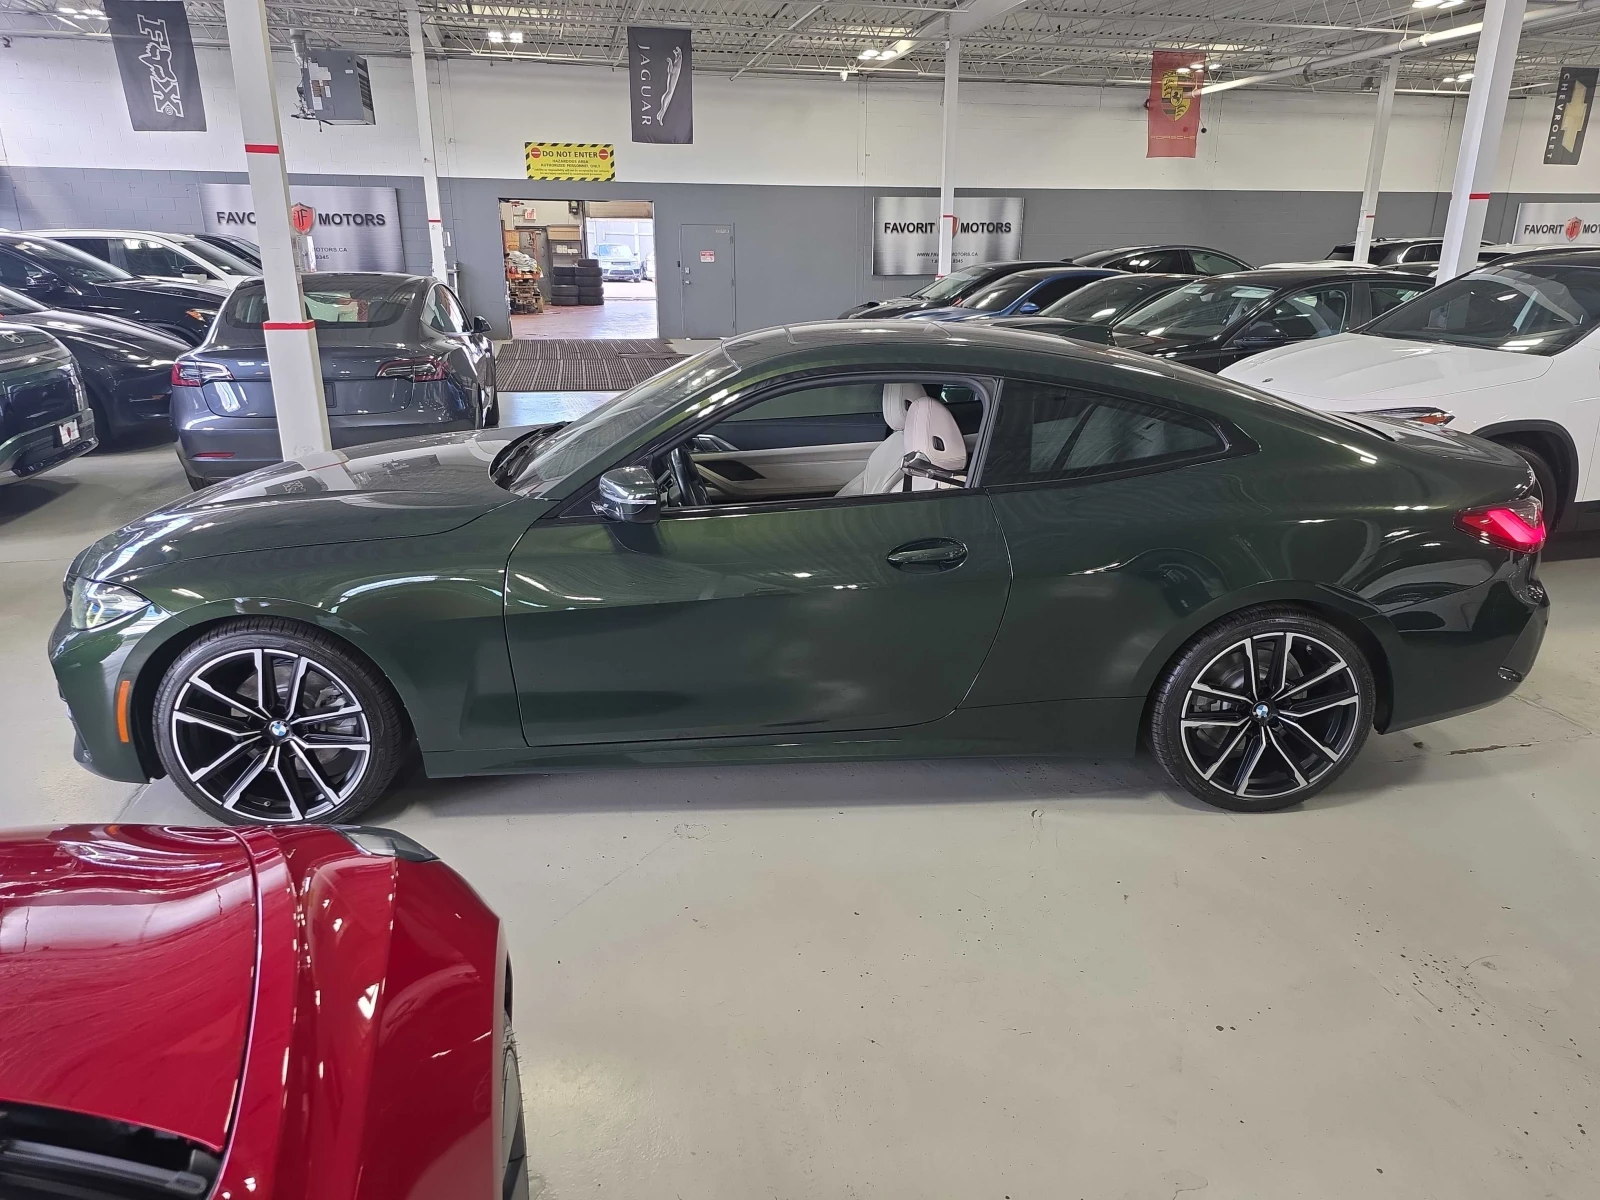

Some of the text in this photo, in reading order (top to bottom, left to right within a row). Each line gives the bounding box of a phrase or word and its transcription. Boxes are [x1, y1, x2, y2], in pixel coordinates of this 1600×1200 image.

[637, 44, 652, 125] JAGUAR
[1547, 73, 1570, 159] CHEVROLET
[542, 150, 554, 158] DO
[574, 151, 598, 159] ENTER
[216, 211, 256, 224] FAVO
[318, 212, 386, 227] MOTORS
[884, 222, 1012, 234] FAVORIT MOTORS
[1523, 224, 1564, 235] FAVORIT
